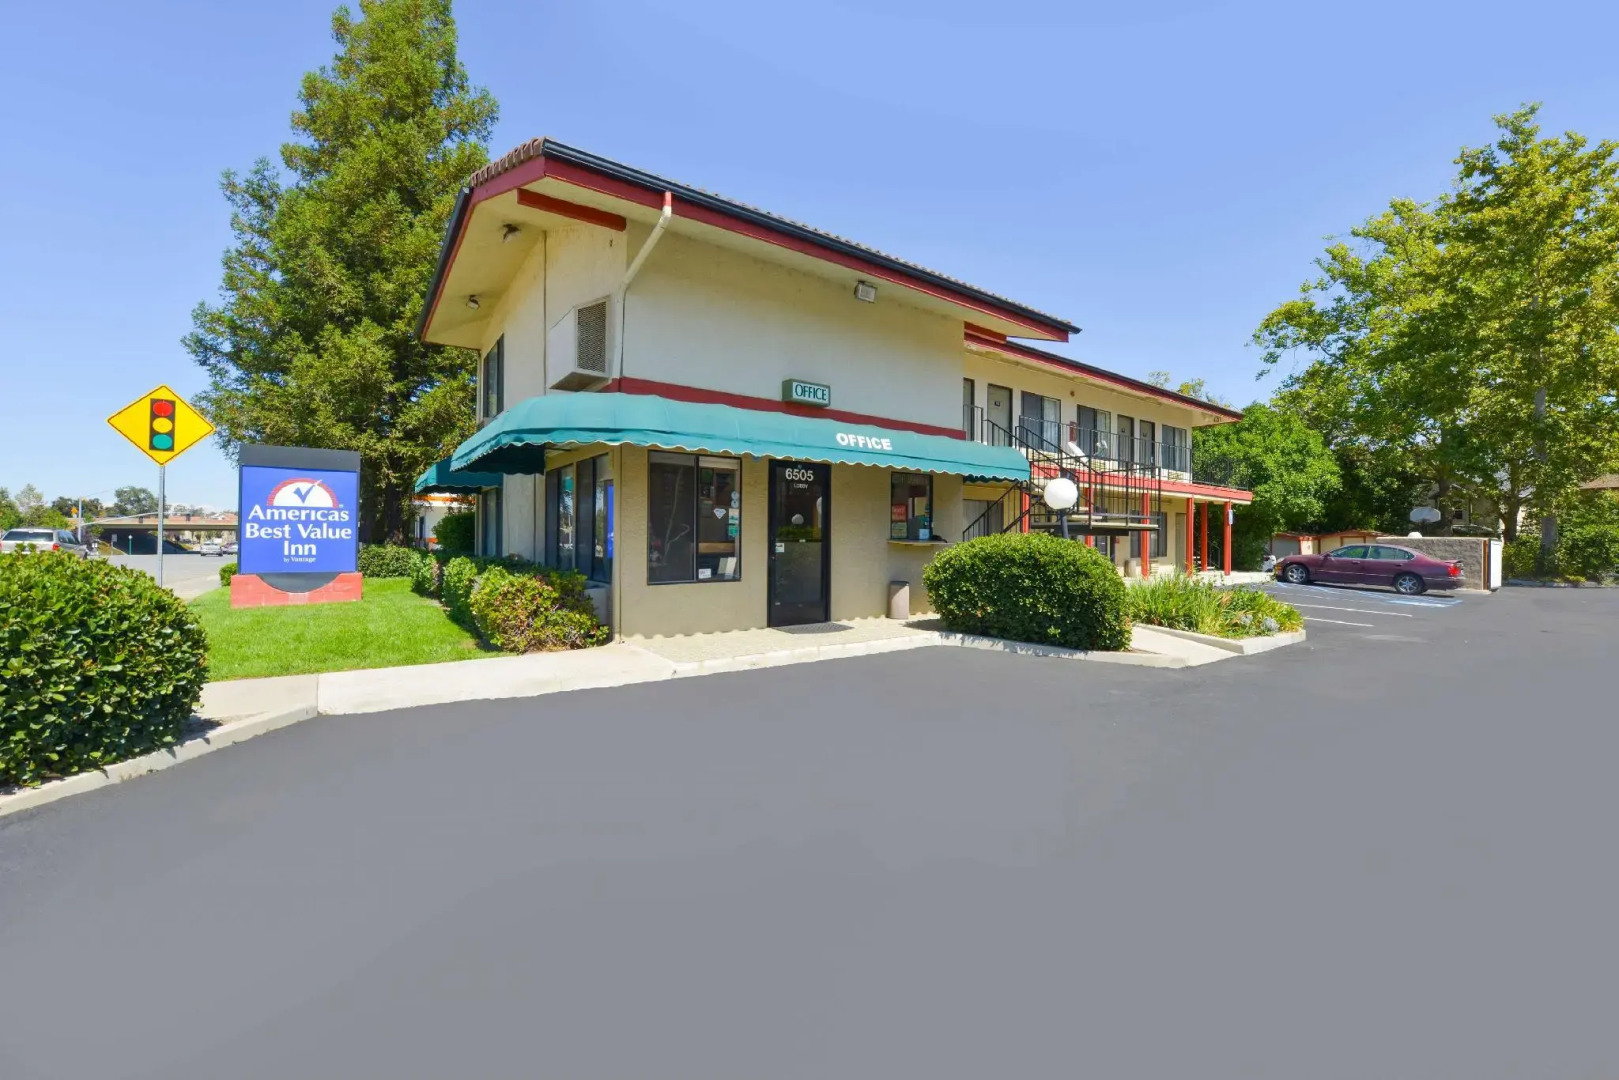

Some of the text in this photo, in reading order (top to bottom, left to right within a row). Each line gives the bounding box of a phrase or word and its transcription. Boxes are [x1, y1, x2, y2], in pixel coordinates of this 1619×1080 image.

[795, 383, 827, 401] OFFICE
[836, 432, 893, 451] OFFICE
[785, 468, 814, 482] 6505
[248, 504, 350, 522] Americas
[245, 522, 353, 540] Best Value
[283, 540, 317, 556] Inn
